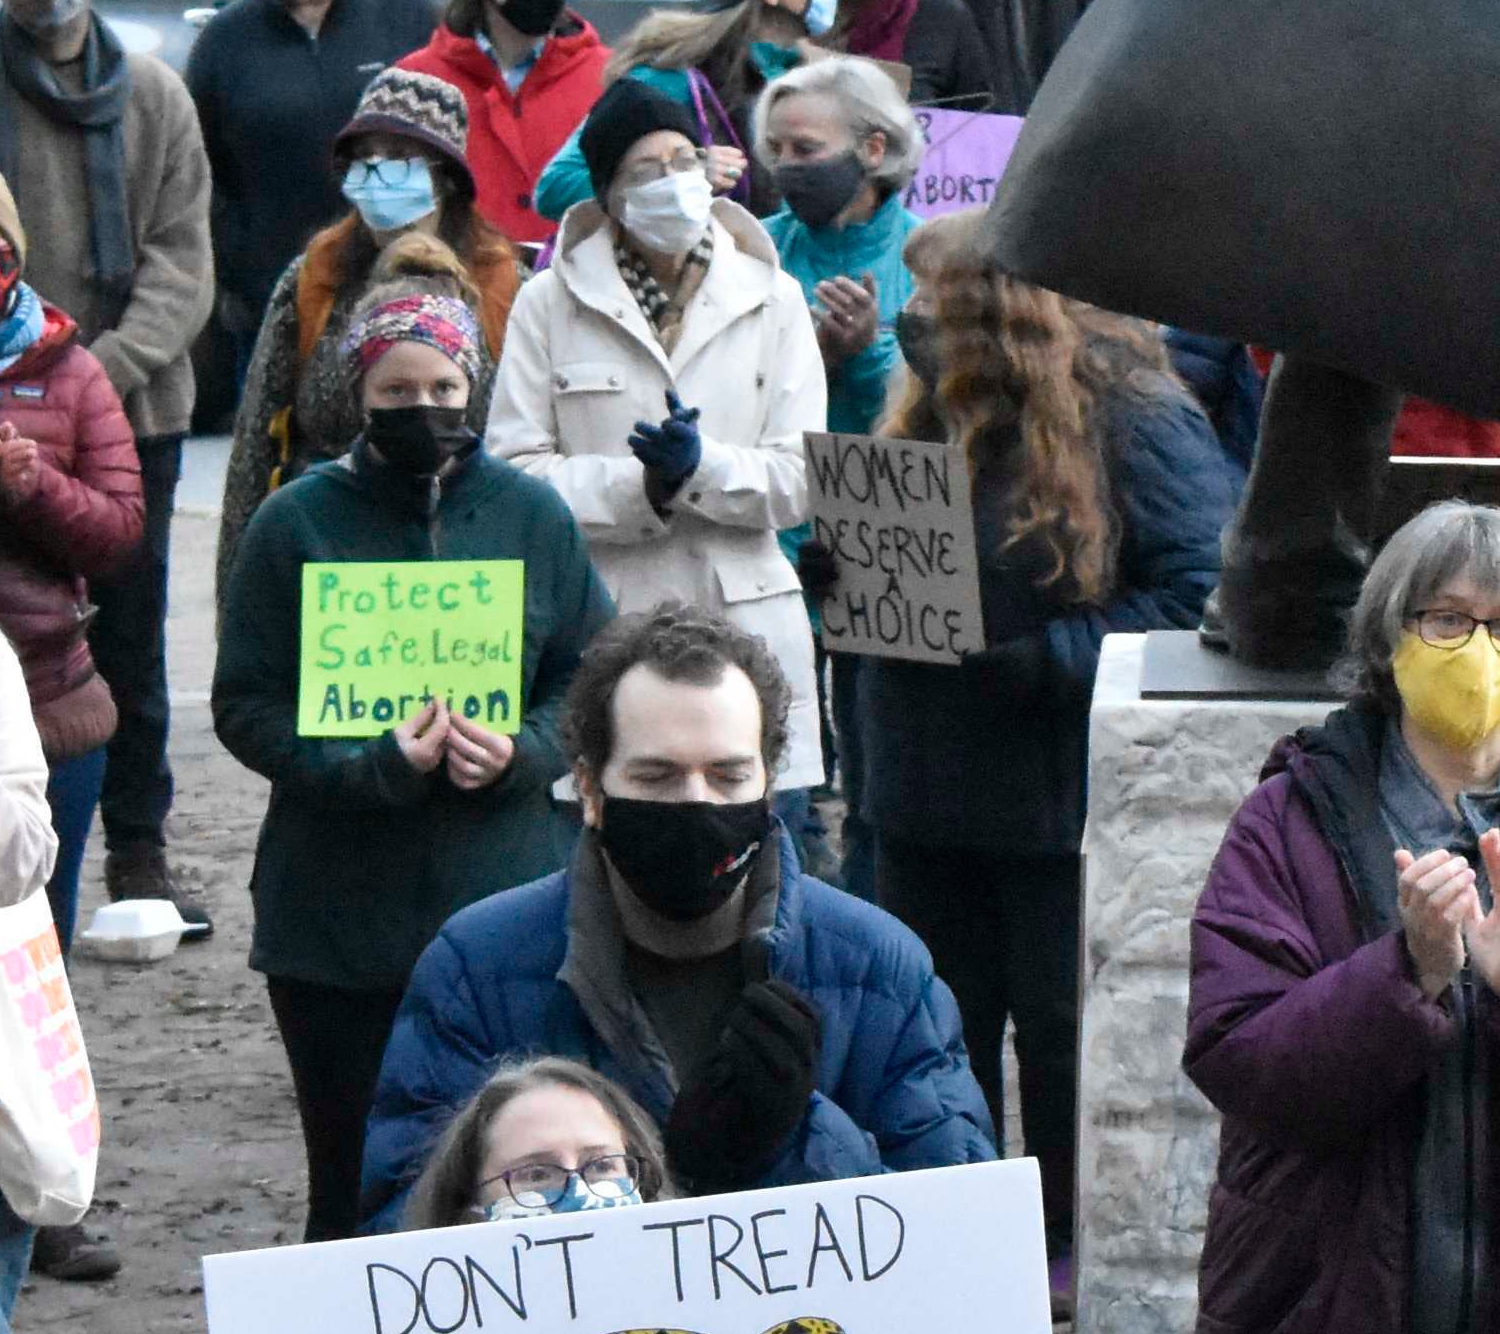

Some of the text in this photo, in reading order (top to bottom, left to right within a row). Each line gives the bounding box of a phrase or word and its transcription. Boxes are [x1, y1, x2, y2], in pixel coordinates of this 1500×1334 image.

[904, 174, 995, 209] ABORT
[808, 435, 951, 512] WOMEN
[814, 515, 959, 579] DESERVE
[318, 571, 493, 613] Protect
[886, 571, 903, 601] A
[820, 590, 970, 657] CHOICE
[431, 627, 513, 667] Legal
[318, 682, 511, 724] Abortion
[642, 1193, 906, 1302] TREAD
